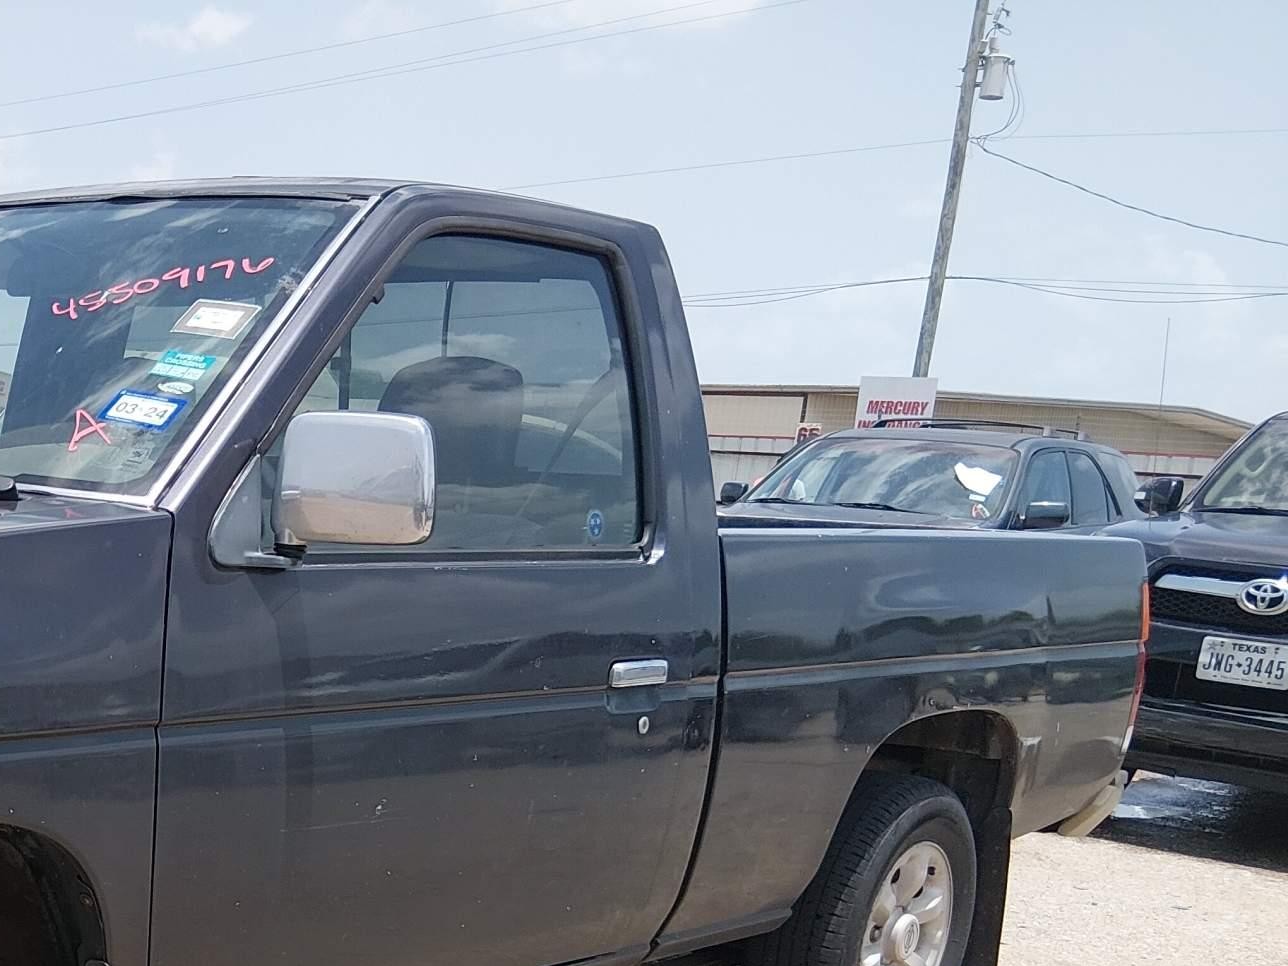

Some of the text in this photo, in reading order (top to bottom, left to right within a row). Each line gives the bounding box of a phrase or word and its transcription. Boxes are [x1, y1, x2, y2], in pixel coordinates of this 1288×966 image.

[51, 257, 275, 320] 45509176
[867, 400, 929, 416] MERCURY
[68, 408, 112, 452] A
[1232, 643, 1268, 655] TEXAS
